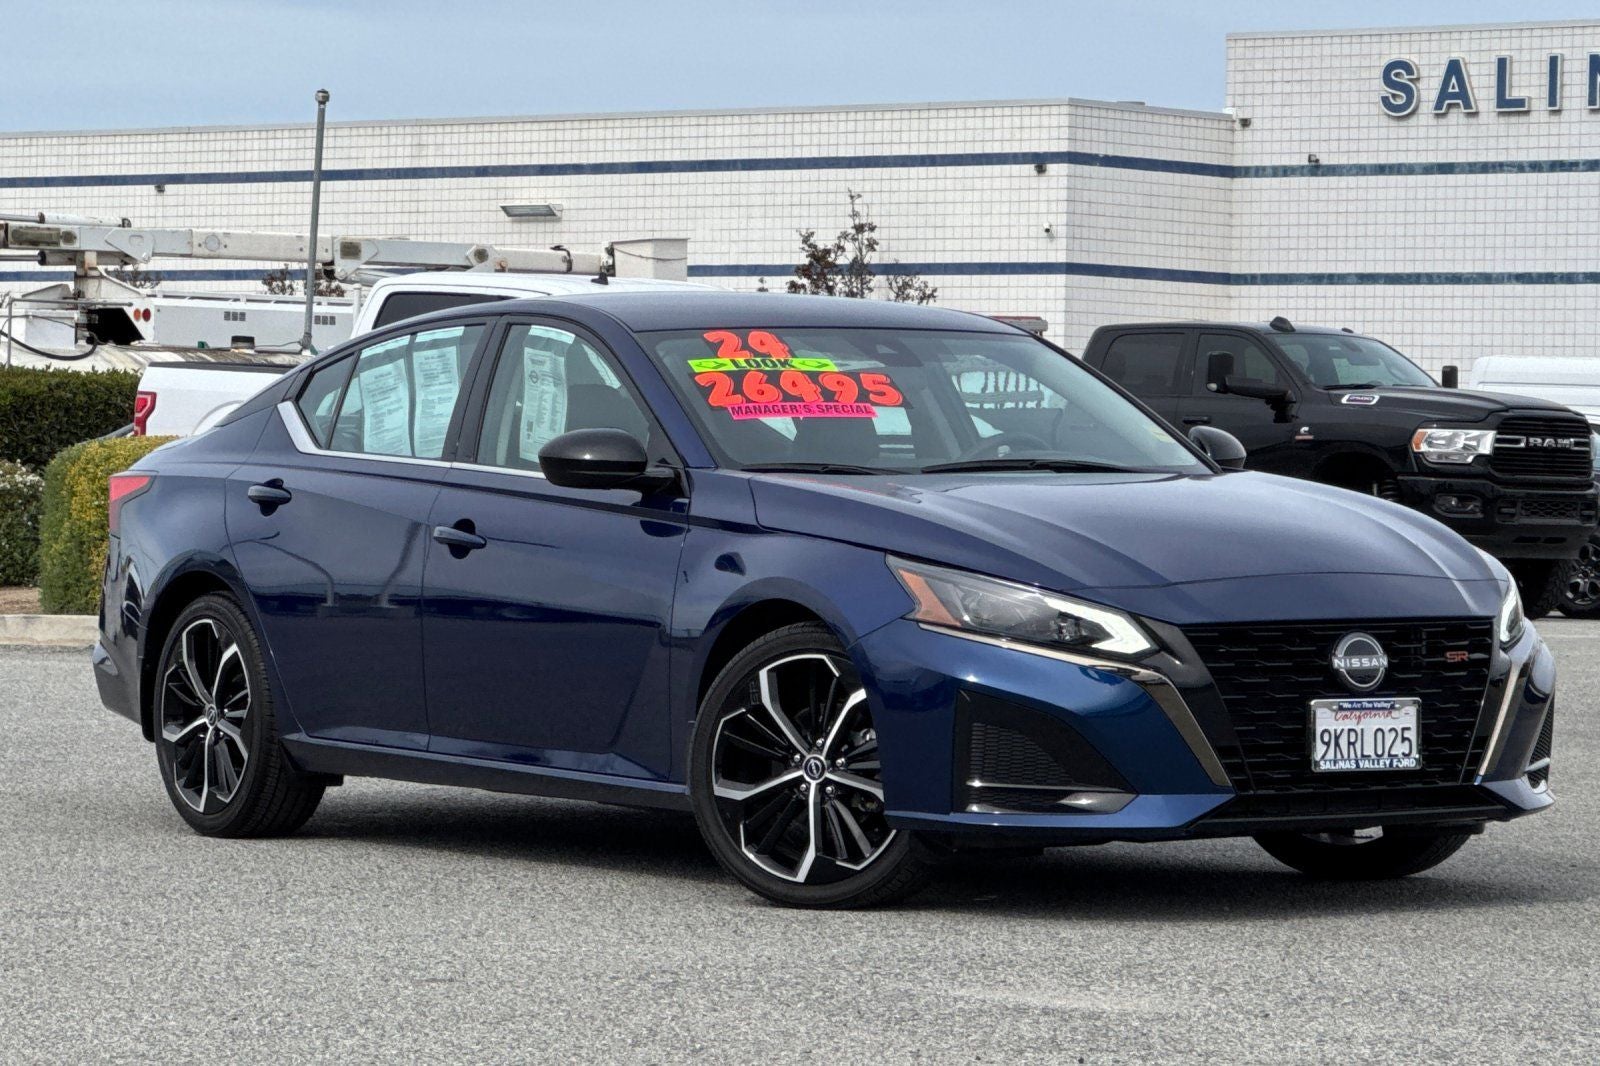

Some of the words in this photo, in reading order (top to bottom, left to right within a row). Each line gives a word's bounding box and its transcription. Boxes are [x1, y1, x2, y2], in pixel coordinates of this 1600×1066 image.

[730, 357, 795, 370] LOOK
[694, 371, 902, 406] 26495
[730, 404, 811, 417] MANAGER'S
[816, 403, 873, 415] SPECIAL
[1529, 437, 1570, 448] RAM
[1334, 657, 1388, 668] NISSAN
[1446, 651, 1468, 662] SR
[1335, 709, 1398, 725] California
[1320, 727, 1413, 759] 9KRL025
[1320, 760, 1357, 770] SALINAS
[1358, 760, 1391, 769] VALLEY
[1392, 758, 1417, 768] FORD
